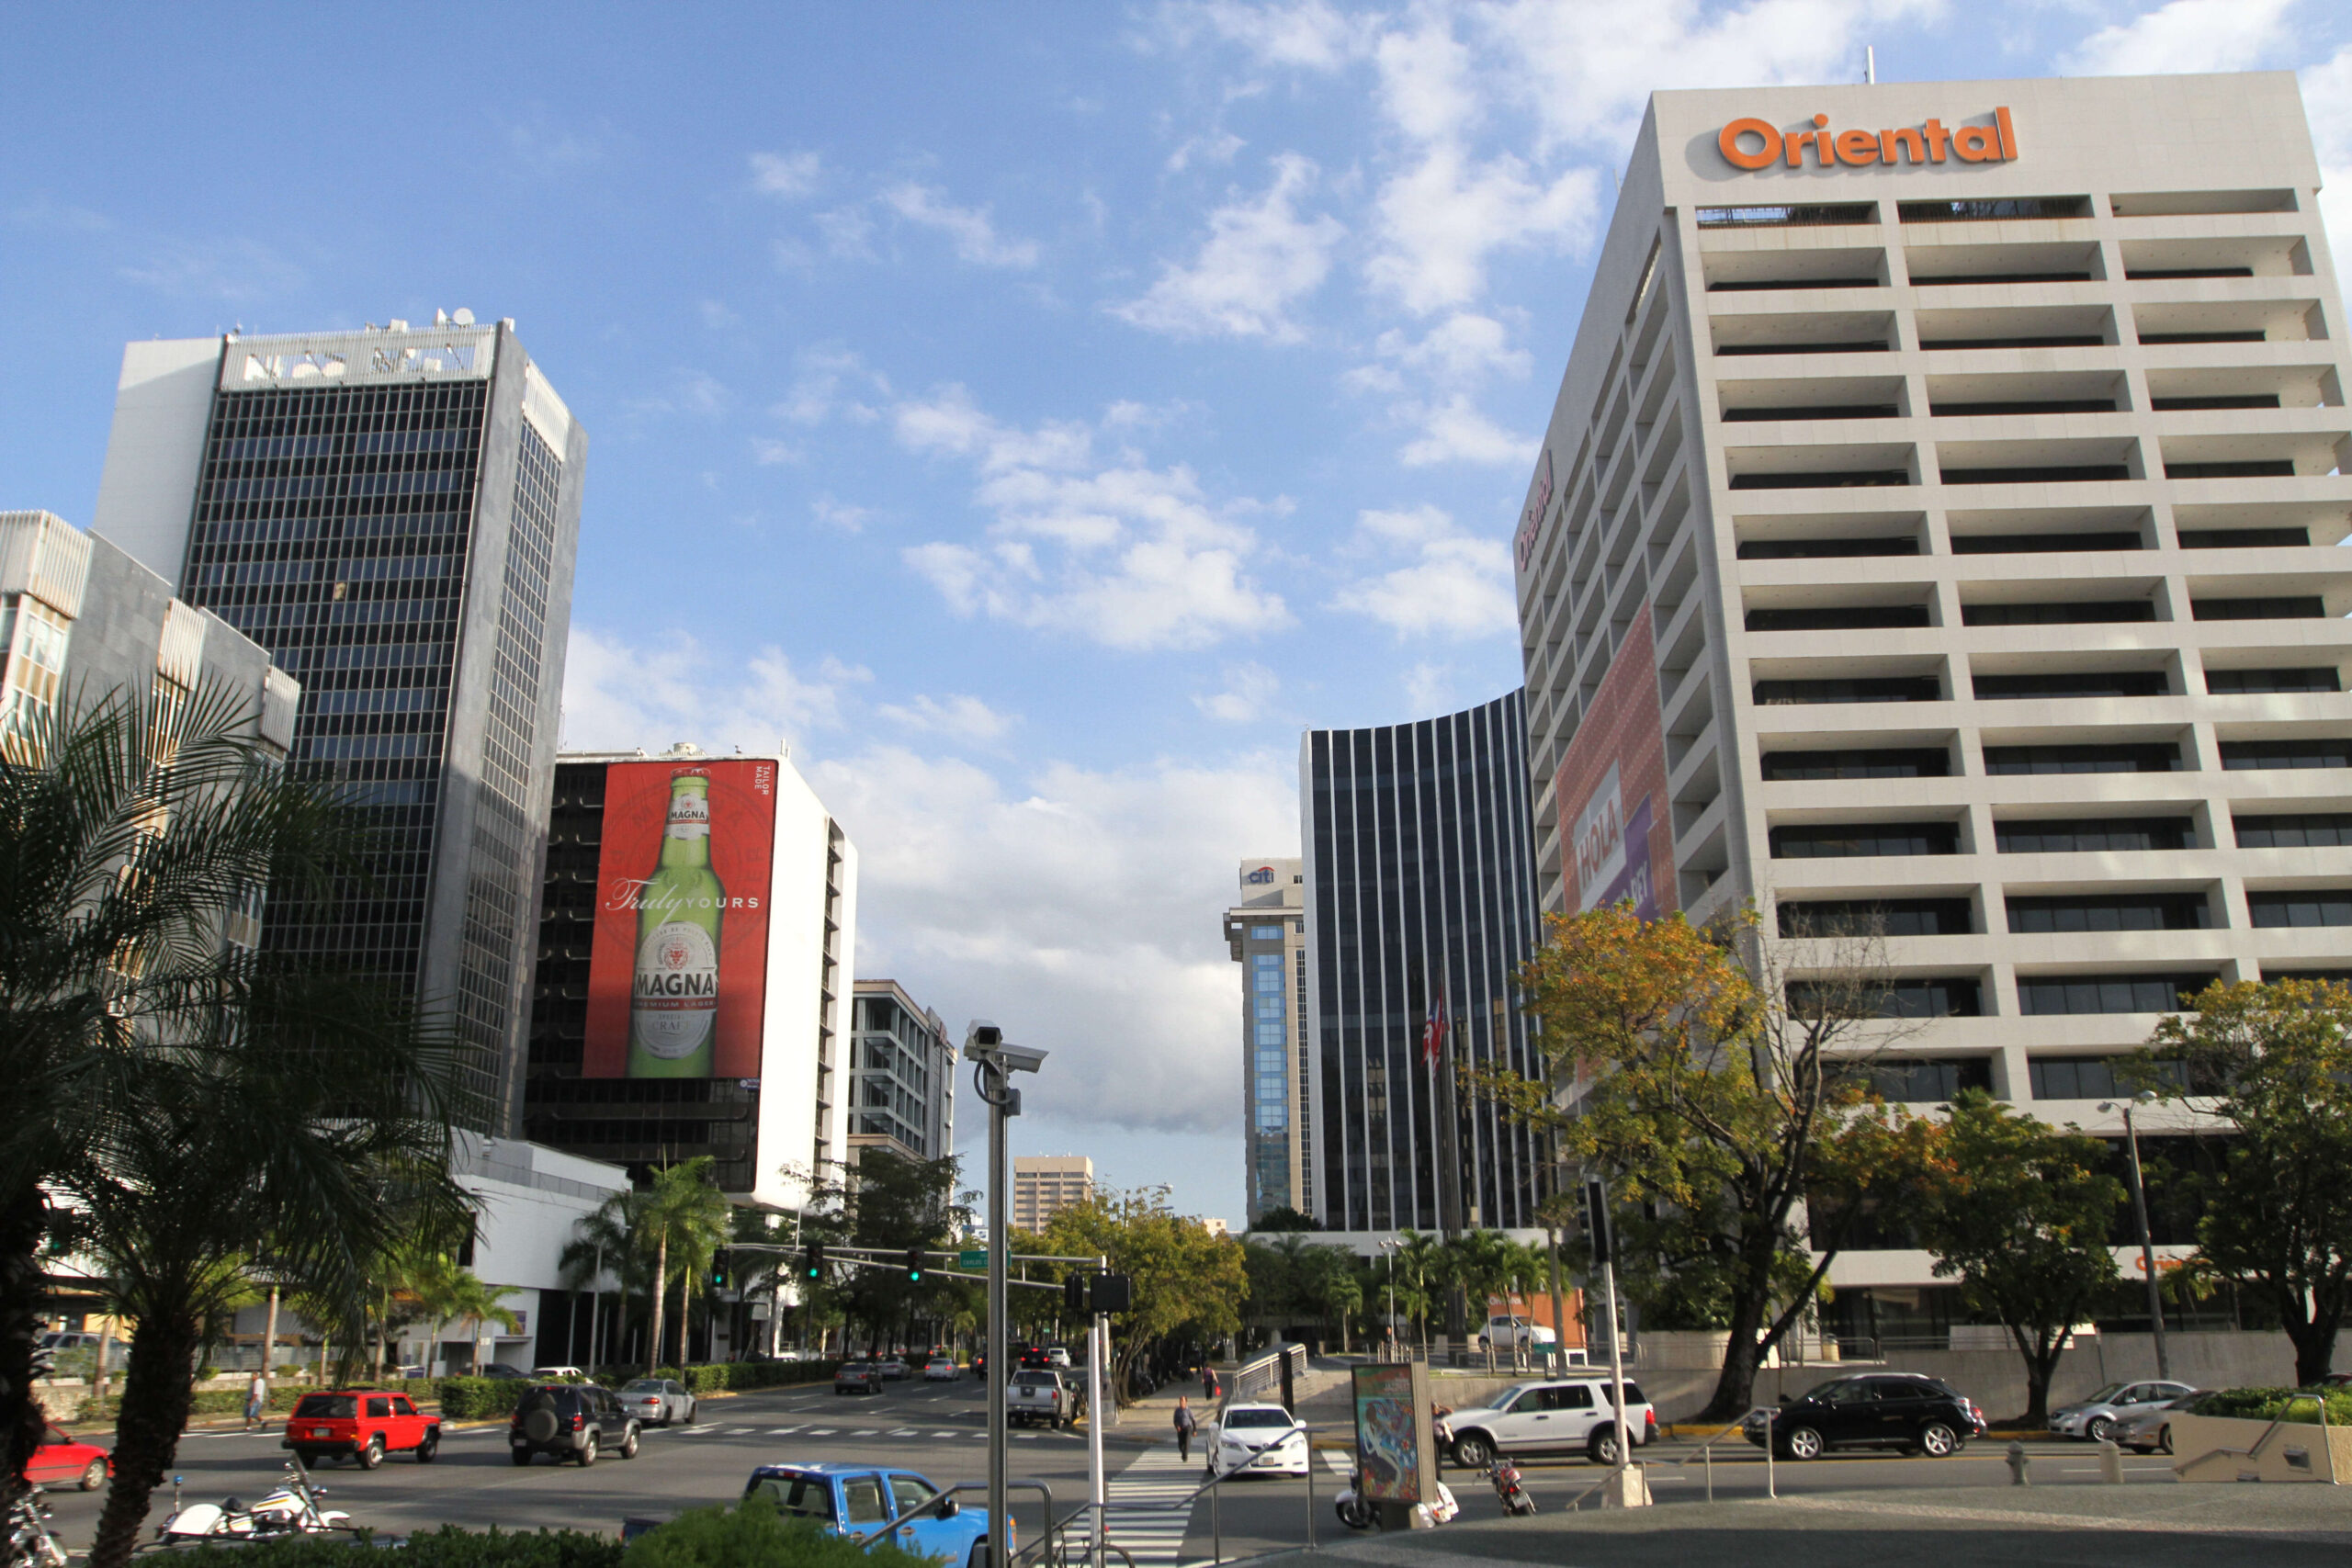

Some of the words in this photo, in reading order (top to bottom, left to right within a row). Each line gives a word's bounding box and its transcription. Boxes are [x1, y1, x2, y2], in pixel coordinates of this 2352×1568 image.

[1718, 107, 2018, 170] Oriental
[754, 766, 763, 789] MADE
[762, 765, 770, 795] TAILOR
[671, 810, 706, 819] MAGNA
[1579, 798, 1619, 889] HOLA
[1249, 866, 1274, 884] citi
[605, 877, 683, 930] Truly
[685, 897, 760, 908] YOURS
[636, 974, 715, 996] MAGNA
